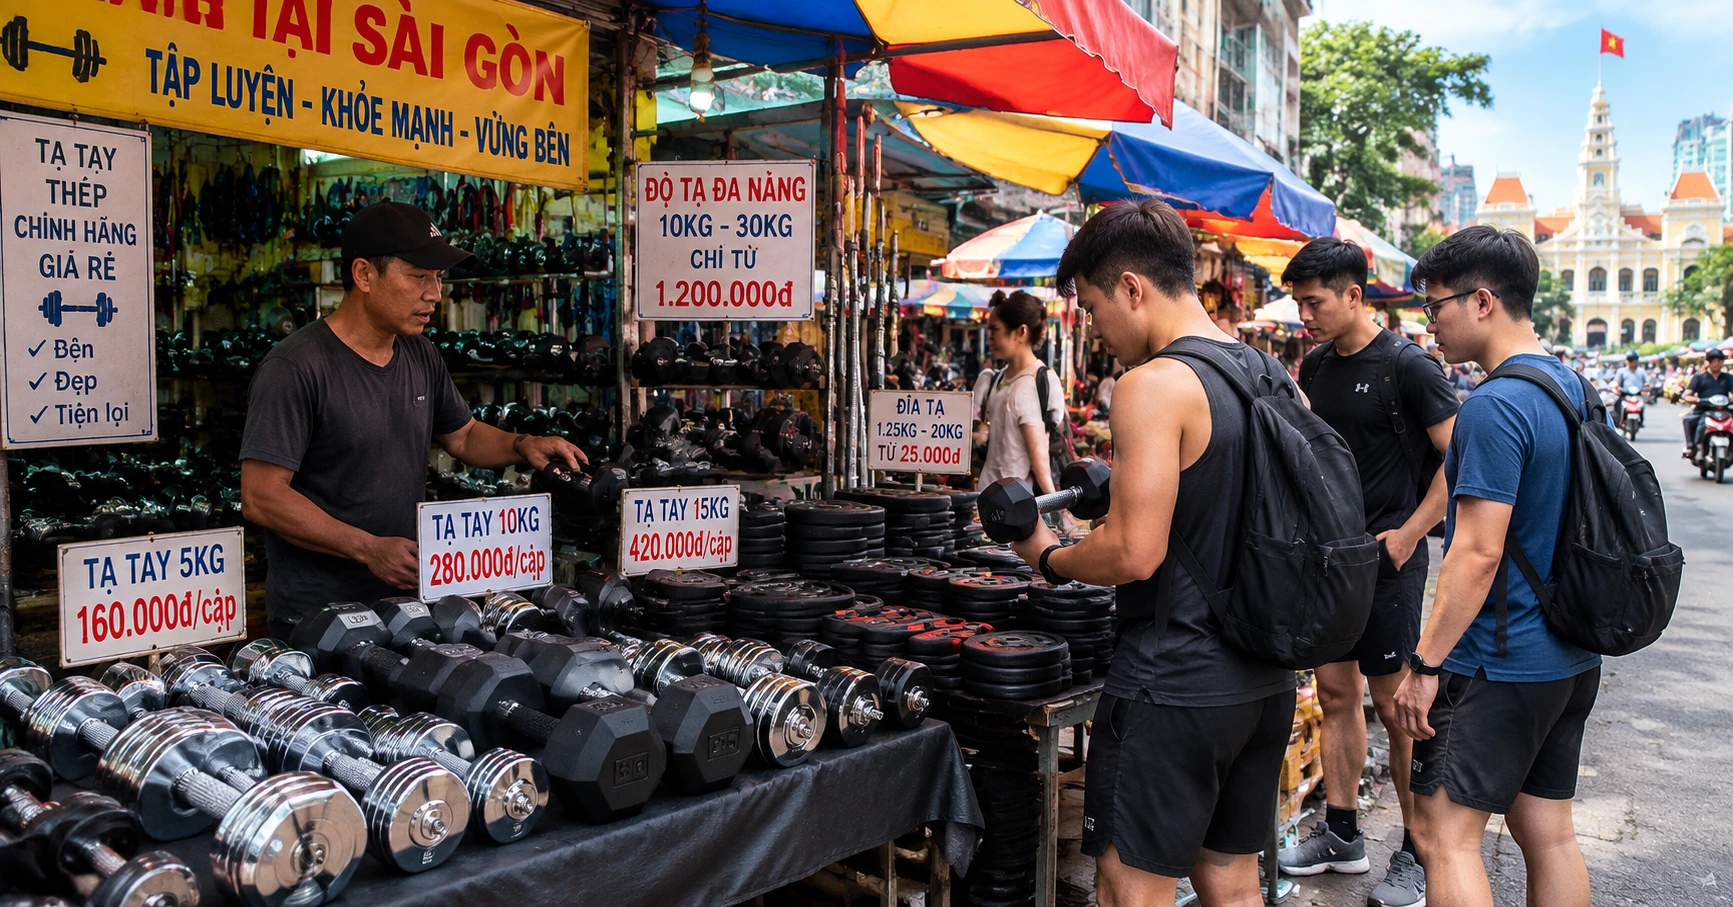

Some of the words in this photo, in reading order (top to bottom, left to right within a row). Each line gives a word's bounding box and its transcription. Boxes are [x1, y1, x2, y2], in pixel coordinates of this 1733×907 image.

[352, 0, 444, 79] SÀI
[464, 23, 565, 106] GÒN
[145, 42, 200, 108] TẬP
[211, 64, 294, 125] LUYỆN
[322, 79, 384, 136] KHỎE
[392, 100, 453, 151] MẠNH
[535, 121, 570, 166] BÊN
[35, 138, 67, 171] TẠ
[46, 176, 107, 208] THÉP
[680, 177, 706, 208] TẠ
[712, 177, 741, 202] ĐA
[84, 216, 137, 246] HÃNG
[659, 213, 713, 238] 10KG
[736, 213, 792, 238] 30KG
[655, 280, 793, 308] 1.200.000đ
[55, 371, 97, 395] Đẹp
[55, 402, 98, 429] Tiện
[926, 399, 945, 419] TẠ
[877, 422, 917, 438] 1.25KG
[931, 424, 963, 439] 20KG
[432, 513, 456, 546] TẠ
[499, 506, 539, 534] 10KG
[634, 499, 655, 528] TẠ
[660, 498, 688, 521] TAY
[694, 496, 729, 520] 15KG
[83, 557, 118, 595] TẠ
[125, 550, 171, 584] TAY
[180, 544, 225, 578] 5KG
